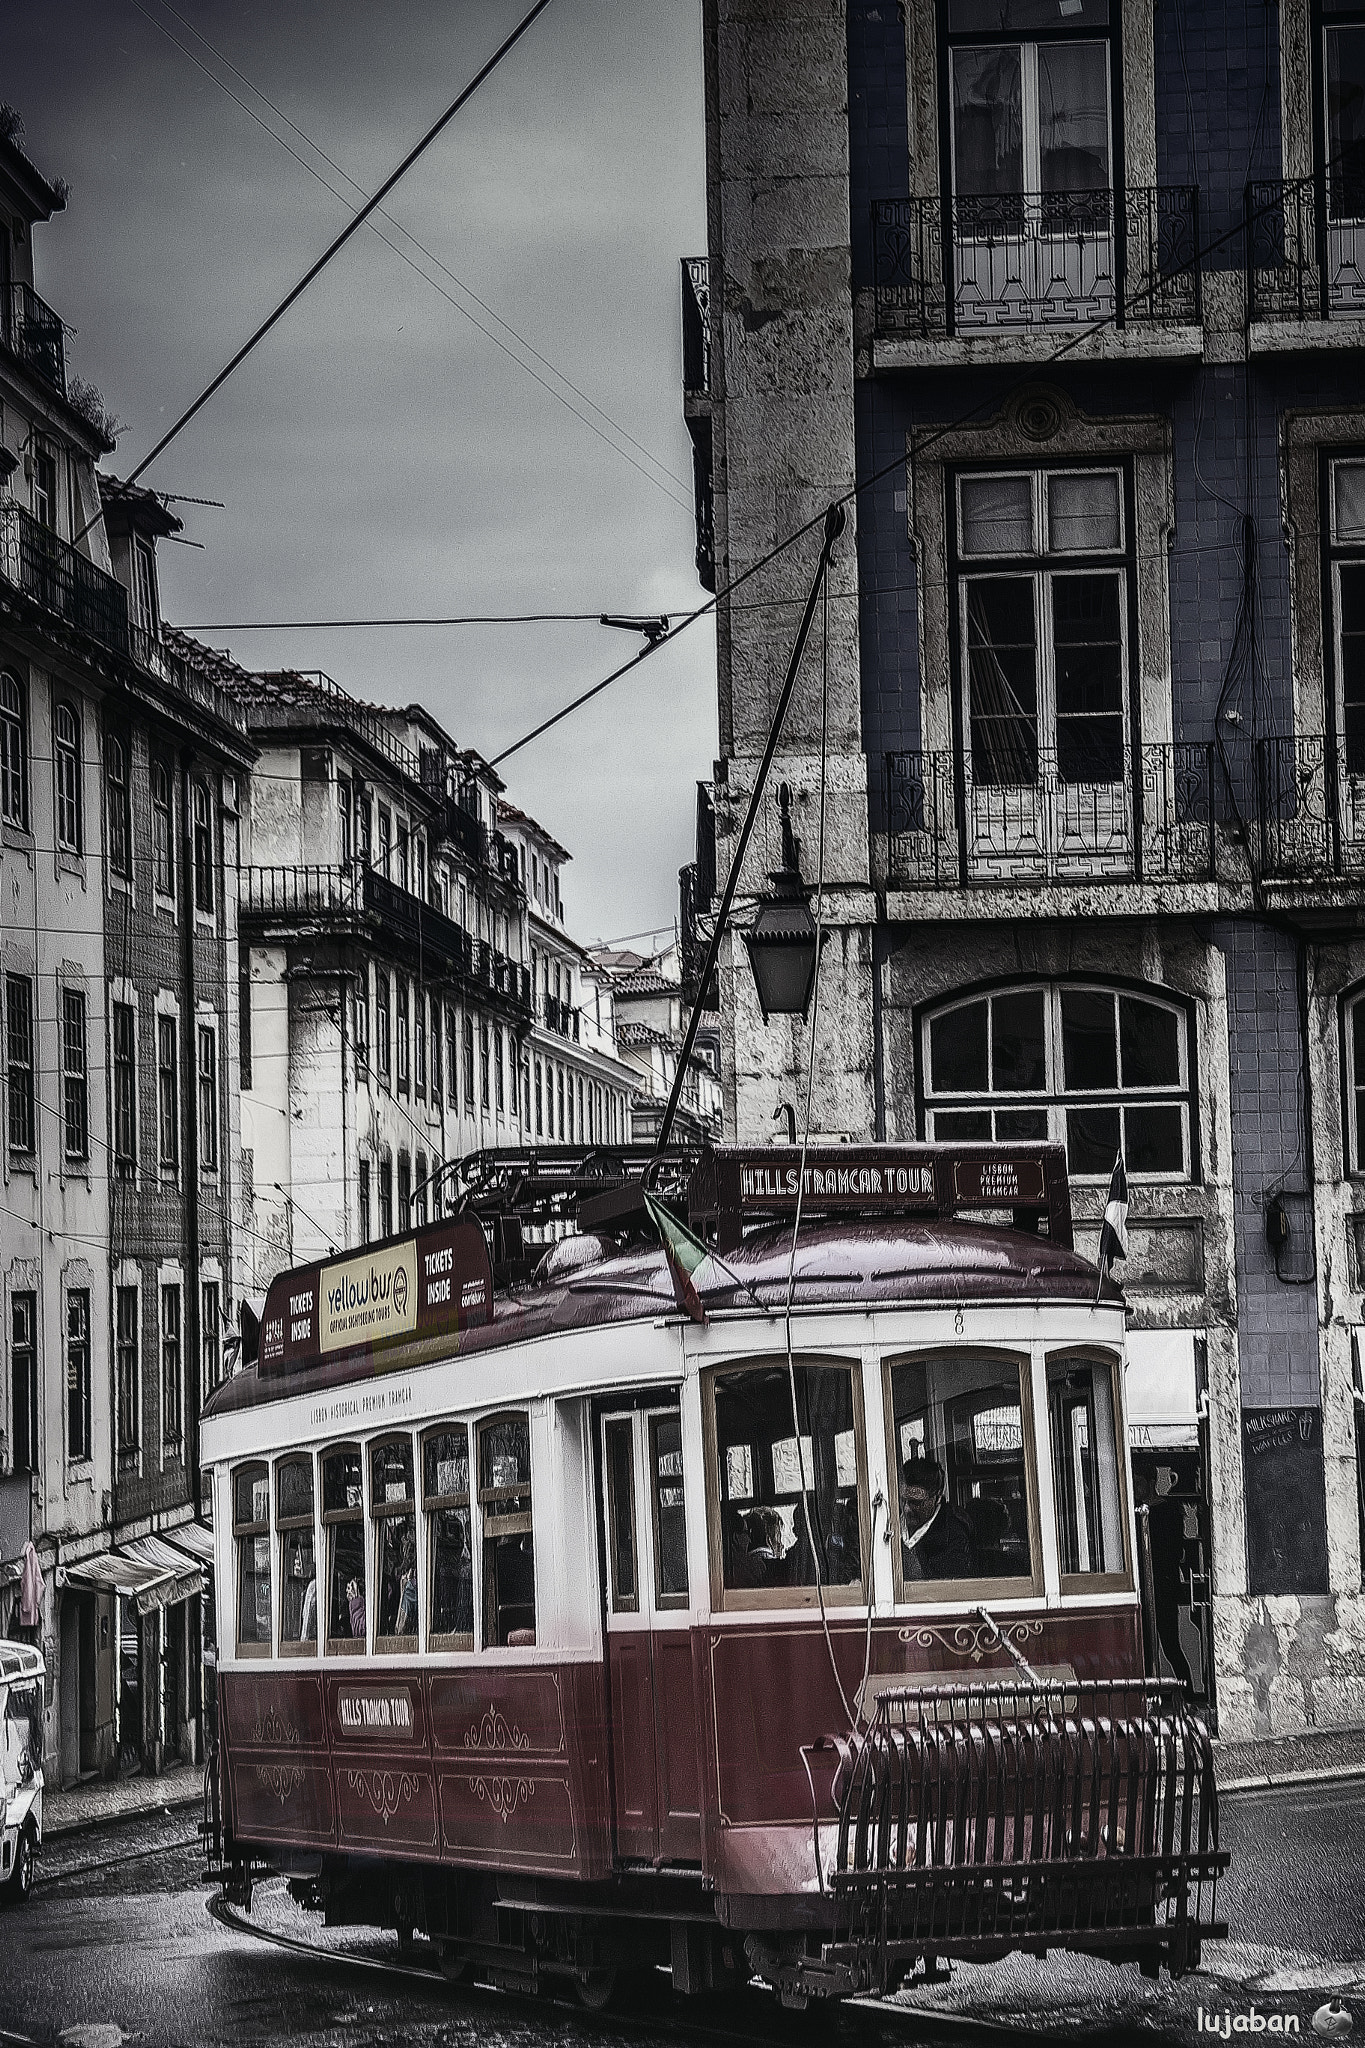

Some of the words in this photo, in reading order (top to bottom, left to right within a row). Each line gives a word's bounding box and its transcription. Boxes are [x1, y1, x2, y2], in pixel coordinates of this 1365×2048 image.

[742, 1168, 799, 1195] HILLS
[803, 1167, 883, 1195] TRAMCAR
[884, 1167, 933, 1194] TOUR
[980, 1174, 1018, 1186] PREMIUM
[982, 1163, 1014, 1175] LISBON
[981, 1185, 1019, 1197] TRAMCAR
[425, 1247, 453, 1277] TICKETS
[289, 1290, 313, 1316] TICKETS
[427, 1277, 451, 1306] INSIDE
[291, 1317, 311, 1343] INSIDE
[329, 1317, 348, 1334] OFFICIAL
[348, 1309, 376, 1330] SIGHTSEEING
[376, 1304, 390, 1322] TOURS
[310, 1406, 328, 1425] LISBON
[330, 1400, 360, 1420] HISTORICAL
[362, 1393, 386, 1413] PREMIUM
[388, 1386, 412, 1407] TRAMCAR
[341, 1697, 361, 1726] HILLS
[391, 1697, 410, 1727] TOUR
